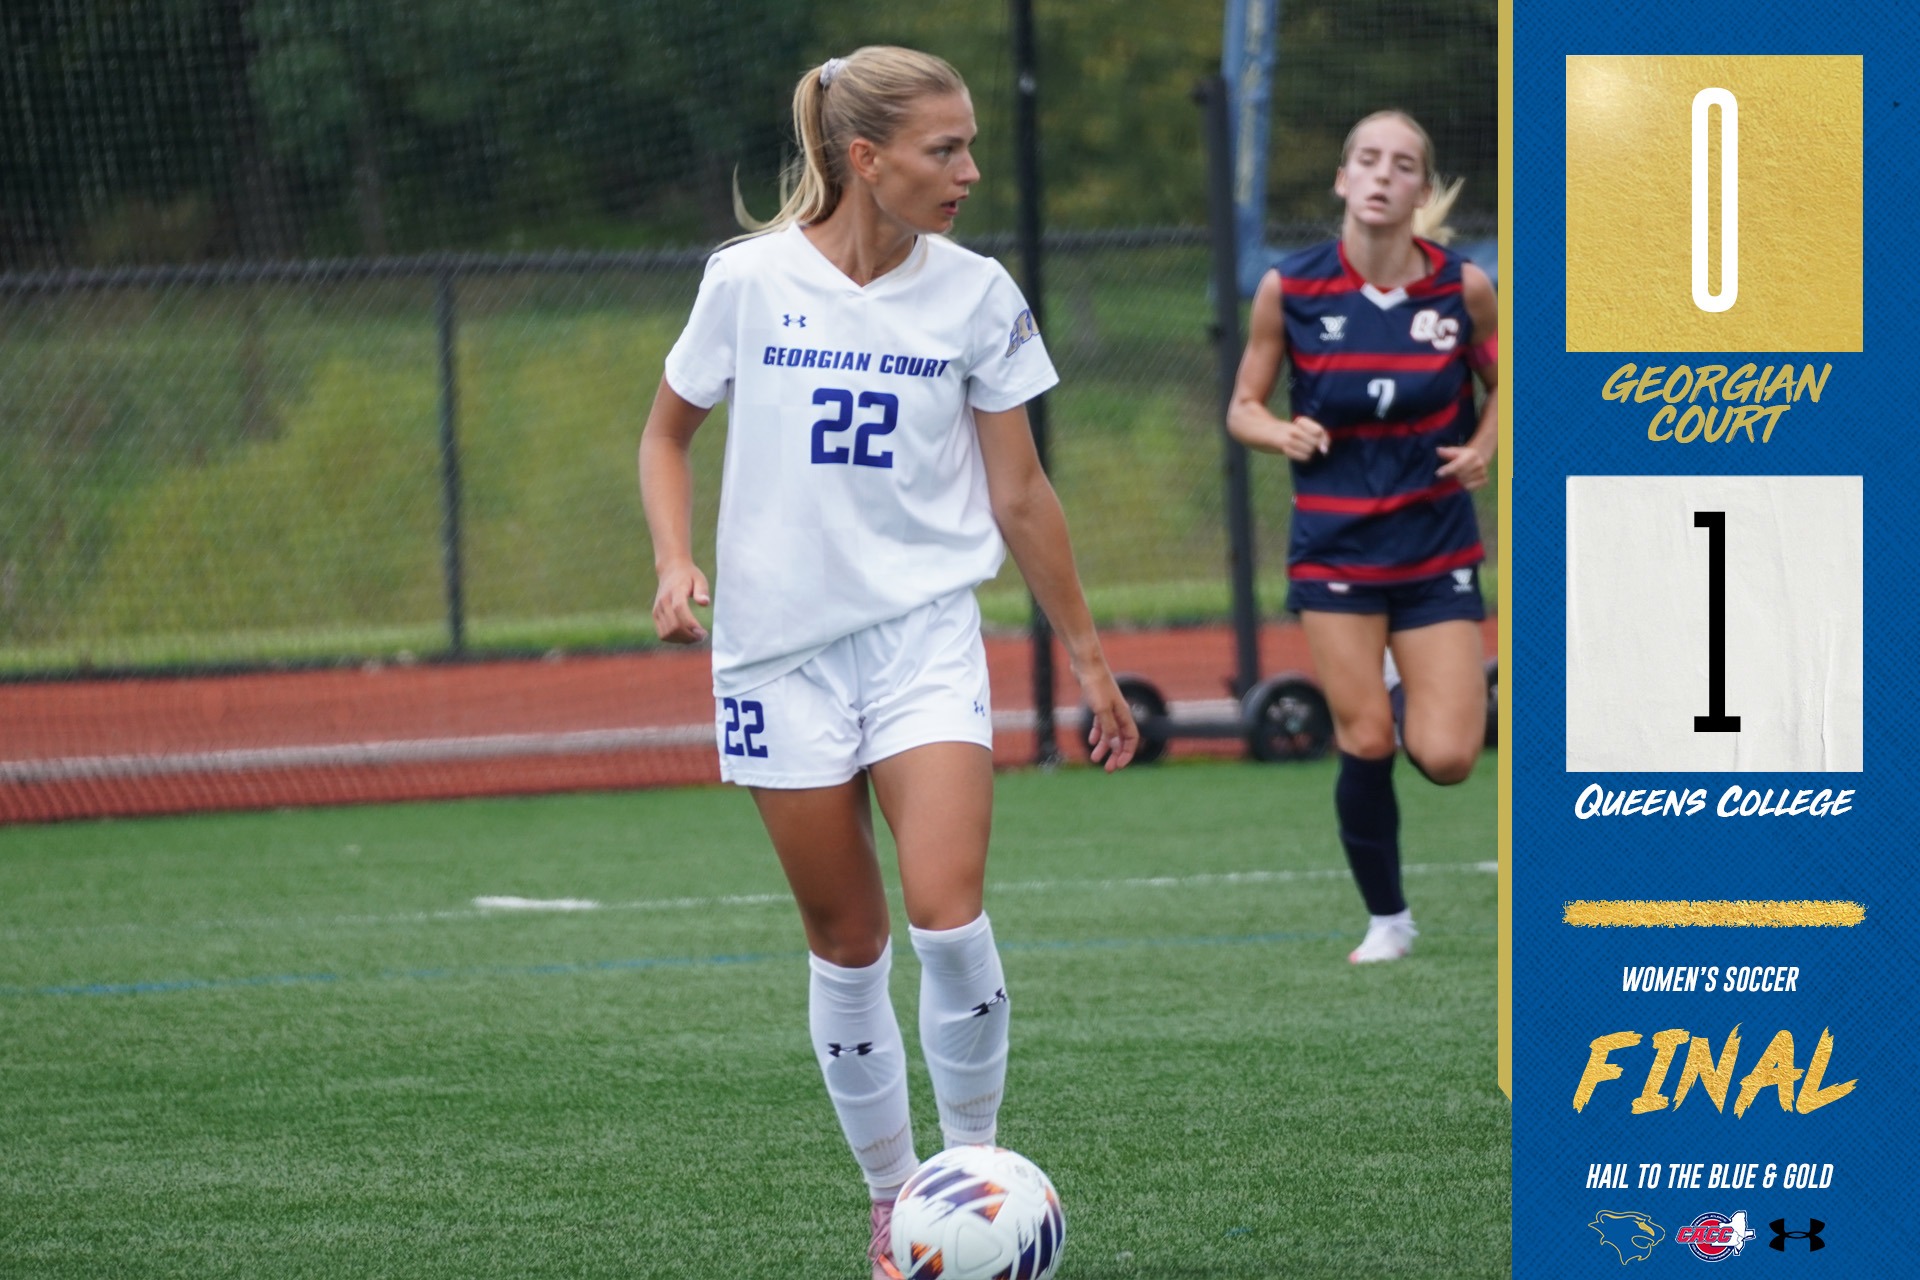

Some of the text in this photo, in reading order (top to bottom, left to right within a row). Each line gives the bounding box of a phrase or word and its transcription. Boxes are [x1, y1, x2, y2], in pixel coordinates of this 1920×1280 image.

[1410, 309, 1459, 350] QC
[763, 346, 950, 378] GEORGIAN COURT
[1367, 378, 1396, 419] 7
[811, 388, 899, 468] 22
[723, 697, 769, 758] 22
